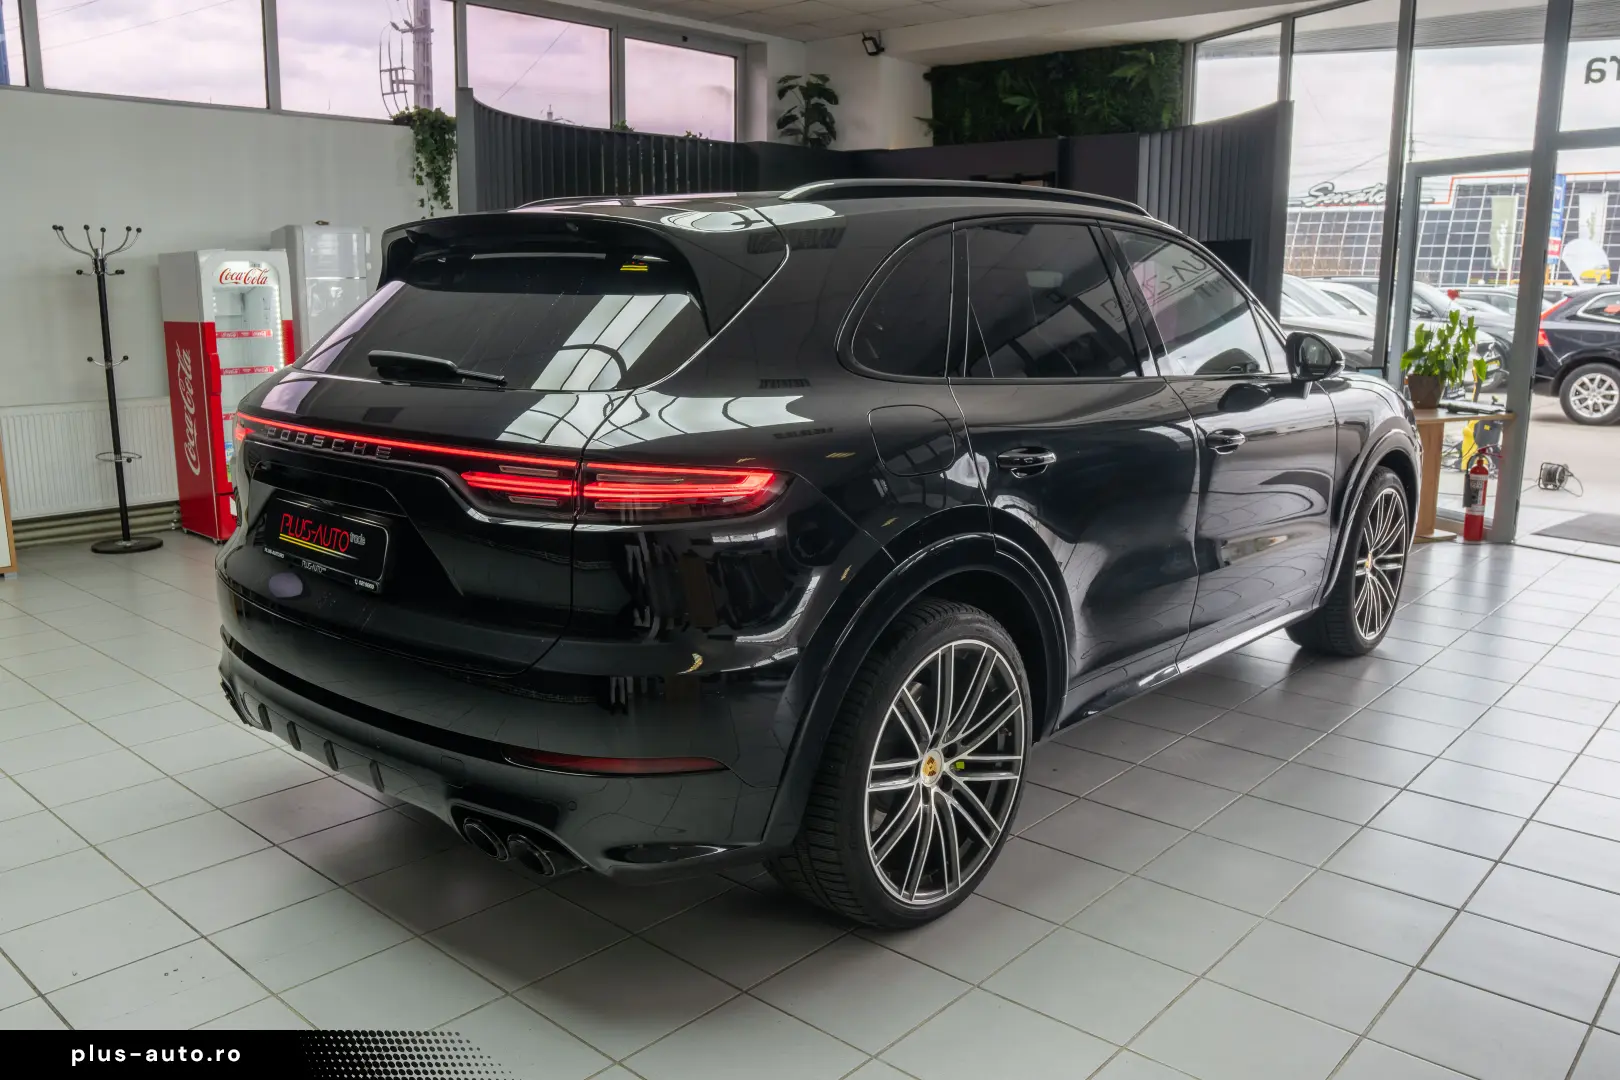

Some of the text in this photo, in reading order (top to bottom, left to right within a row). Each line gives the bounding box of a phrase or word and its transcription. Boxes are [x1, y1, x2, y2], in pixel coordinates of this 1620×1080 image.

[219, 267, 270, 285] Coca-Cola
[175, 340, 200, 476] Coca-Cola
[265, 426, 392, 460] PORSCHE
[280, 513, 349, 552] PLUS-AUTO
